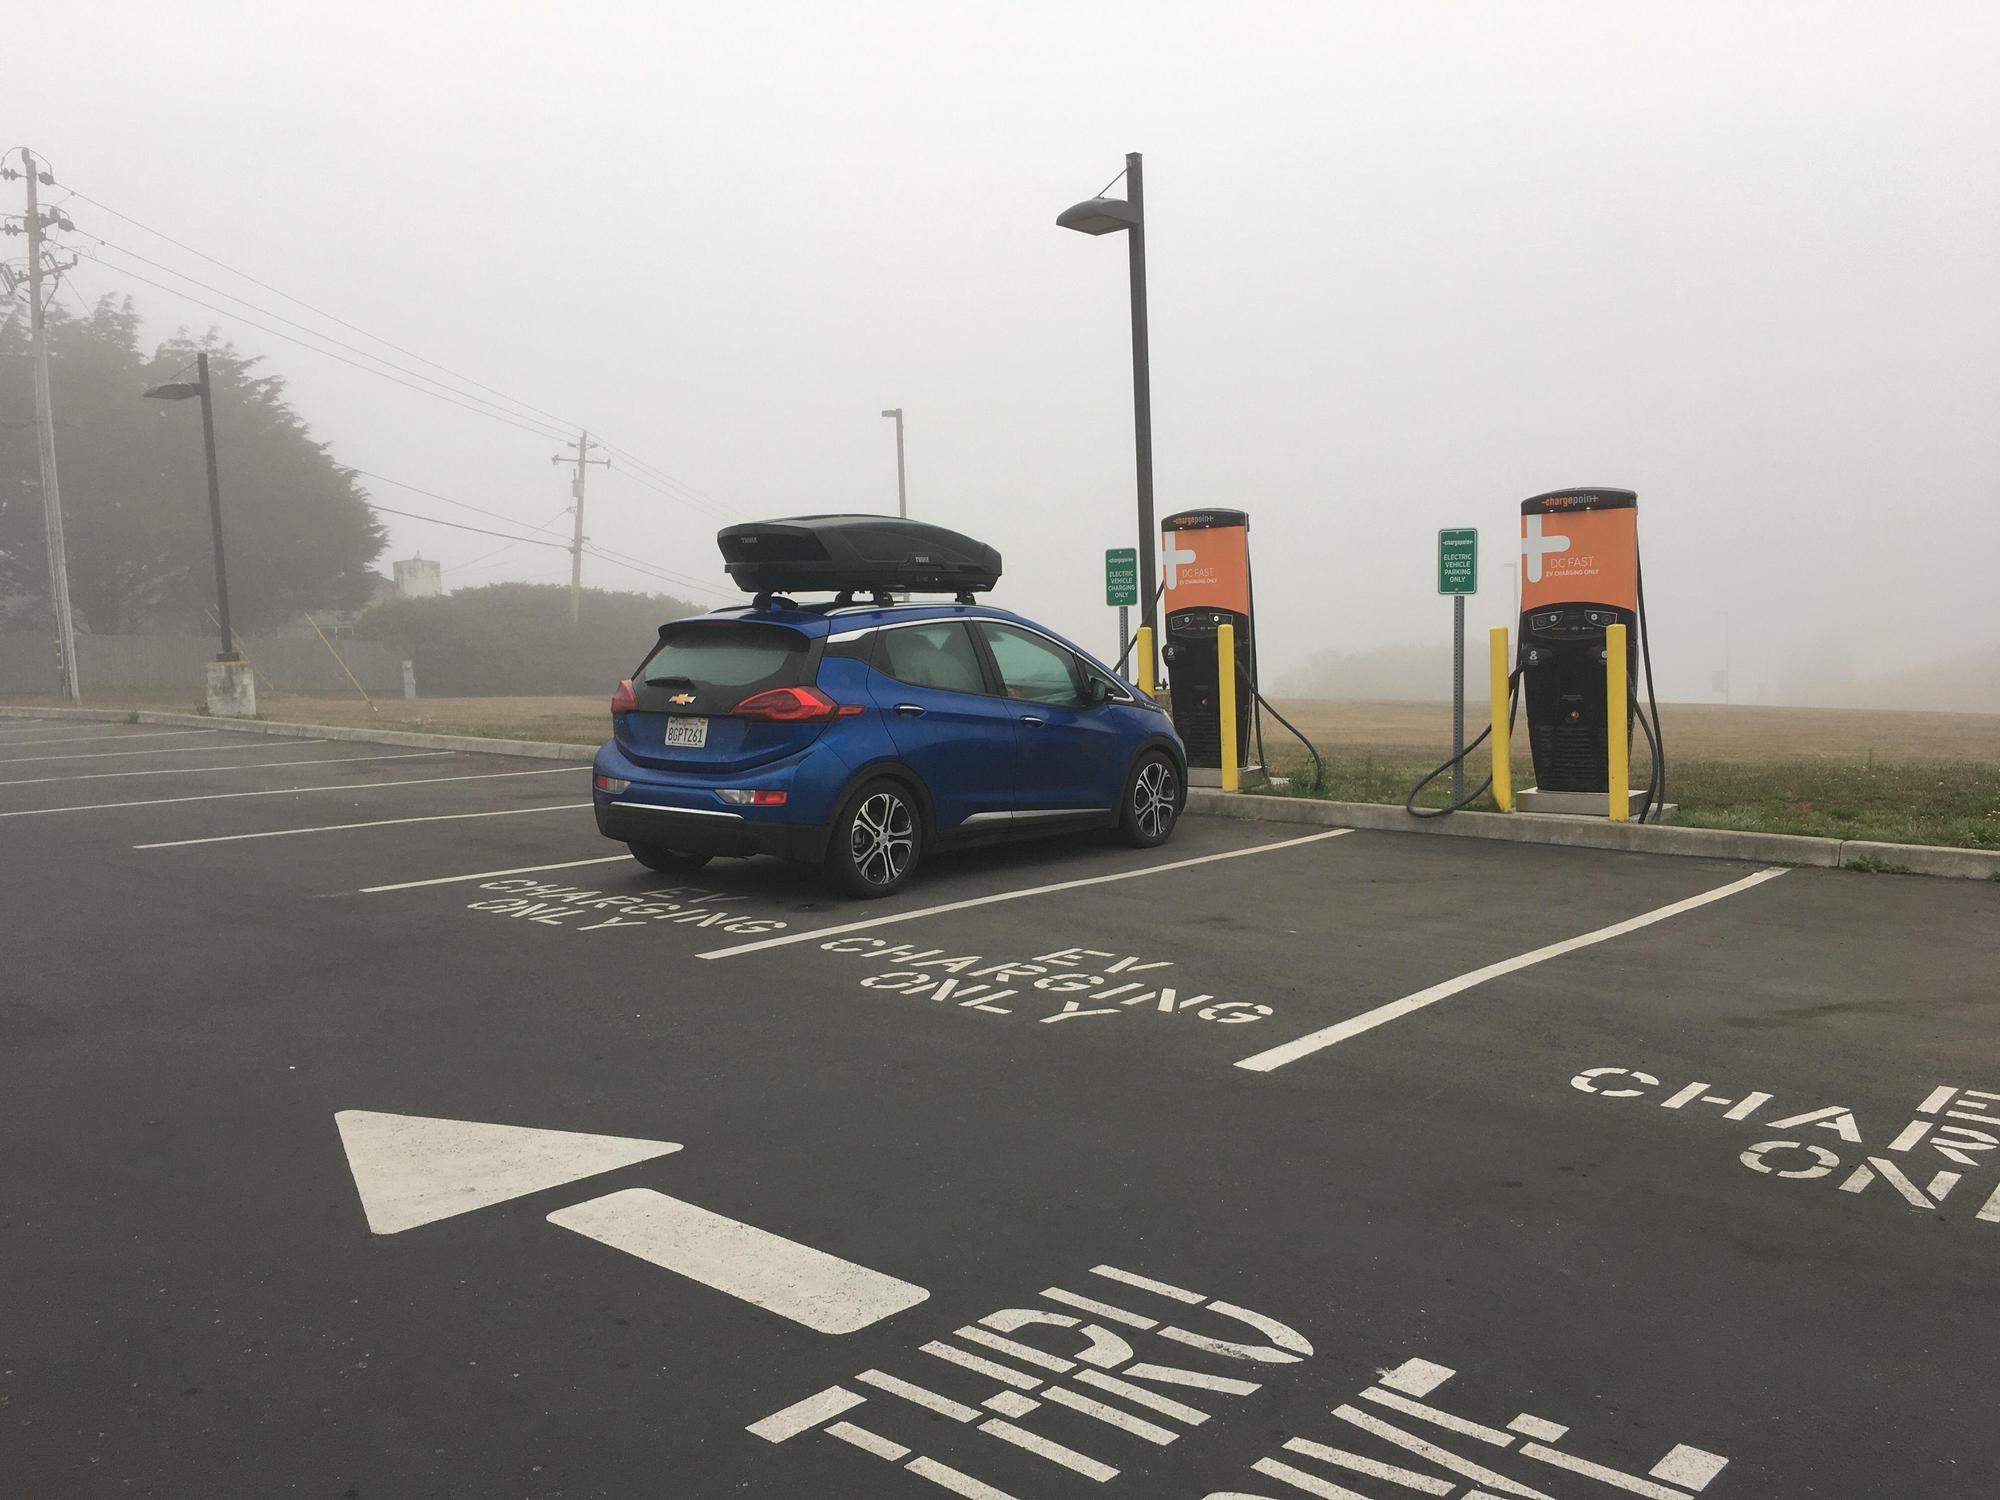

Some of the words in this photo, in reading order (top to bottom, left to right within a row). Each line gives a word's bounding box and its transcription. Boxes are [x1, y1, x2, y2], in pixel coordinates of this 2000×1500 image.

[1182, 568, 1193, 578] DC
[1194, 567, 1215, 577] FAST
[1443, 553, 1472, 561] ELECTRIC
[1550, 558, 1566, 569] DC
[1567, 555, 1595, 568] FAST
[1554, 569, 1583, 577] CHARGING
[1583, 568, 1600, 576] ONLY
[667, 727, 703, 743] 8GPT261
[479, 879, 787, 933] CHARGING
[640, 886, 748, 903] EV
[467, 898, 647, 931] ONLY
[1032, 948, 1174, 973] EV
[820, 937, 1274, 1024] CHARGING
[860, 972, 1121, 1024] ONLY
[1570, 1067, 2000, 1166] CHAR
[1916, 1086, 2000, 1125] E
[1739, 1141, 2000, 1223] ON
[745, 1264, 1314, 1500] THRU
